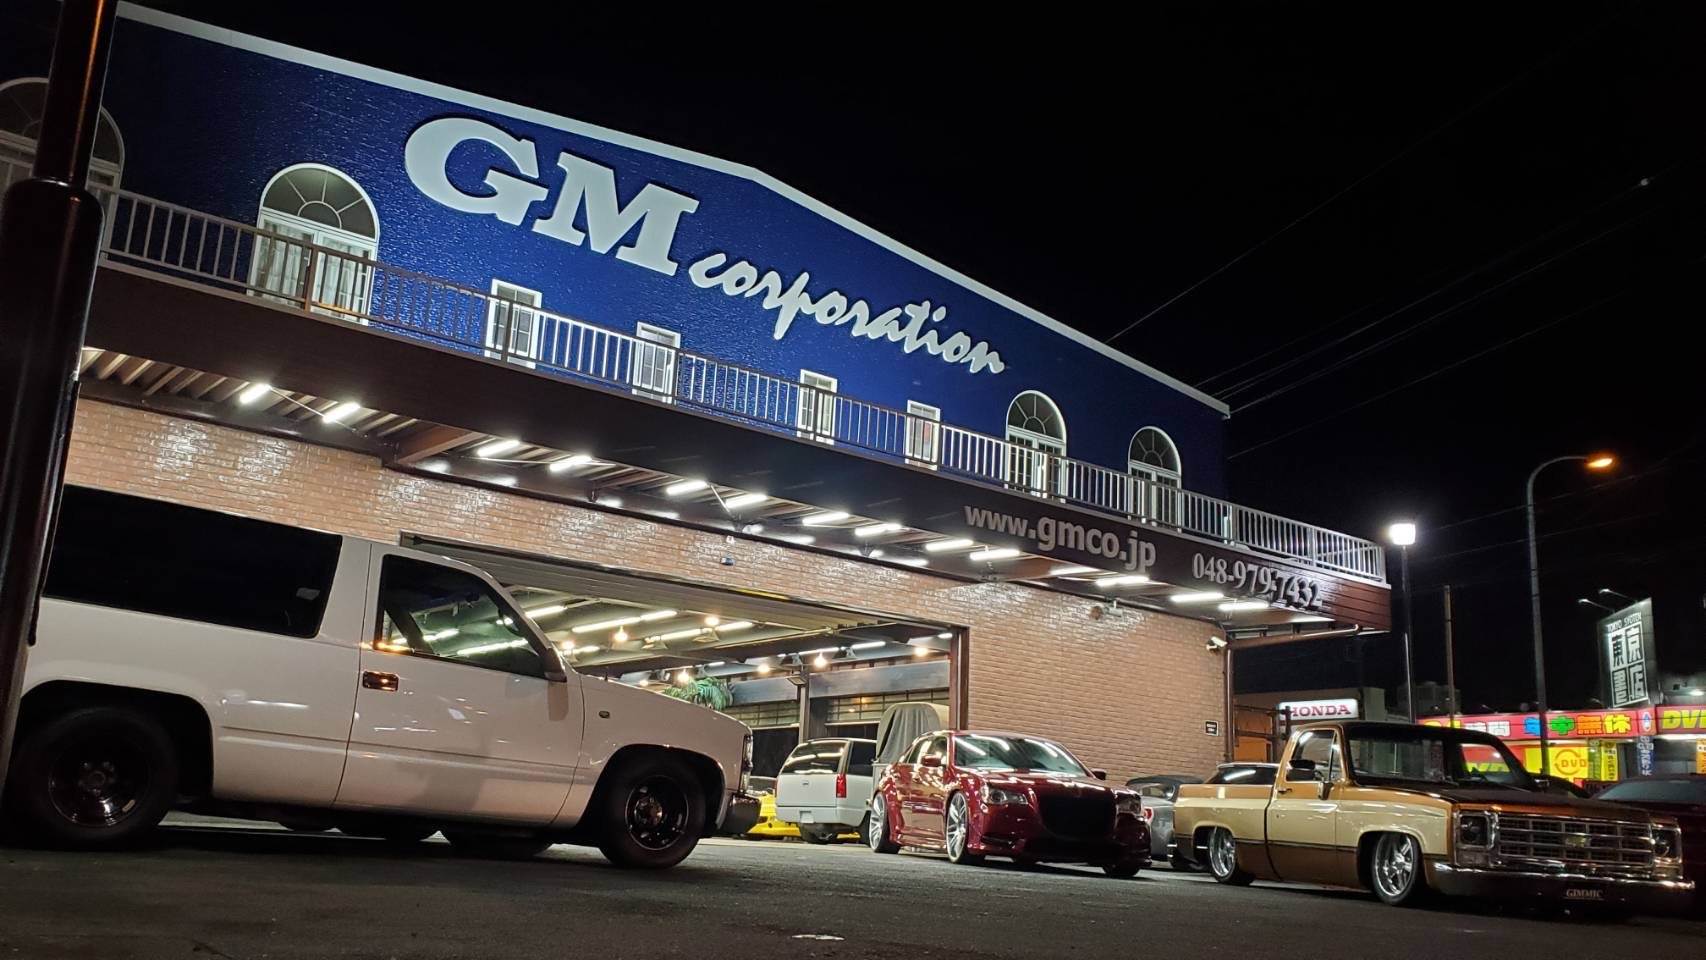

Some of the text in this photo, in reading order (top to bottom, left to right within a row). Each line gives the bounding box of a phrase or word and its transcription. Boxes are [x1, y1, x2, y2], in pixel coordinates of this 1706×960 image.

[404, 117, 1005, 373] GM corporation
[964, 505, 1157, 574] www.gmco.jp
[1192, 553, 1323, 608] 048-979-7432
[1286, 704, 1351, 717] HONDA
[1561, 758, 1587, 768] DVD
